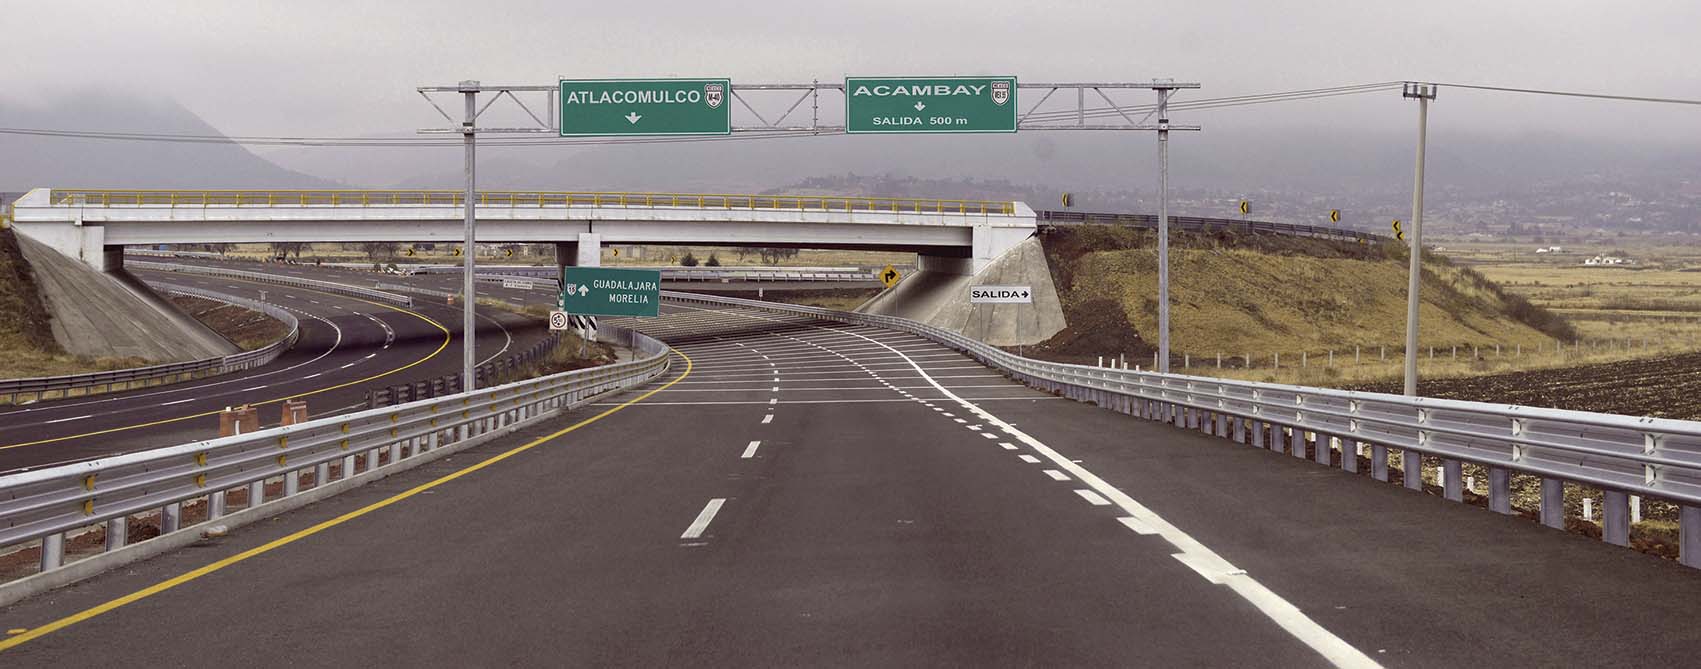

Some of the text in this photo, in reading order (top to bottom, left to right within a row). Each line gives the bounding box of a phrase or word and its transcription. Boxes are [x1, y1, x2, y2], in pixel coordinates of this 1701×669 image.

[853, 85, 986, 96] ACAMBAY
[567, 90, 700, 104] ATLACOMULCO
[873, 117, 922, 125] SALIDA
[929, 117, 951, 125] 500
[593, 279, 657, 291] GUADALAJARA
[609, 293, 649, 304] MORELIA
[972, 290, 1020, 298] SALIDA
